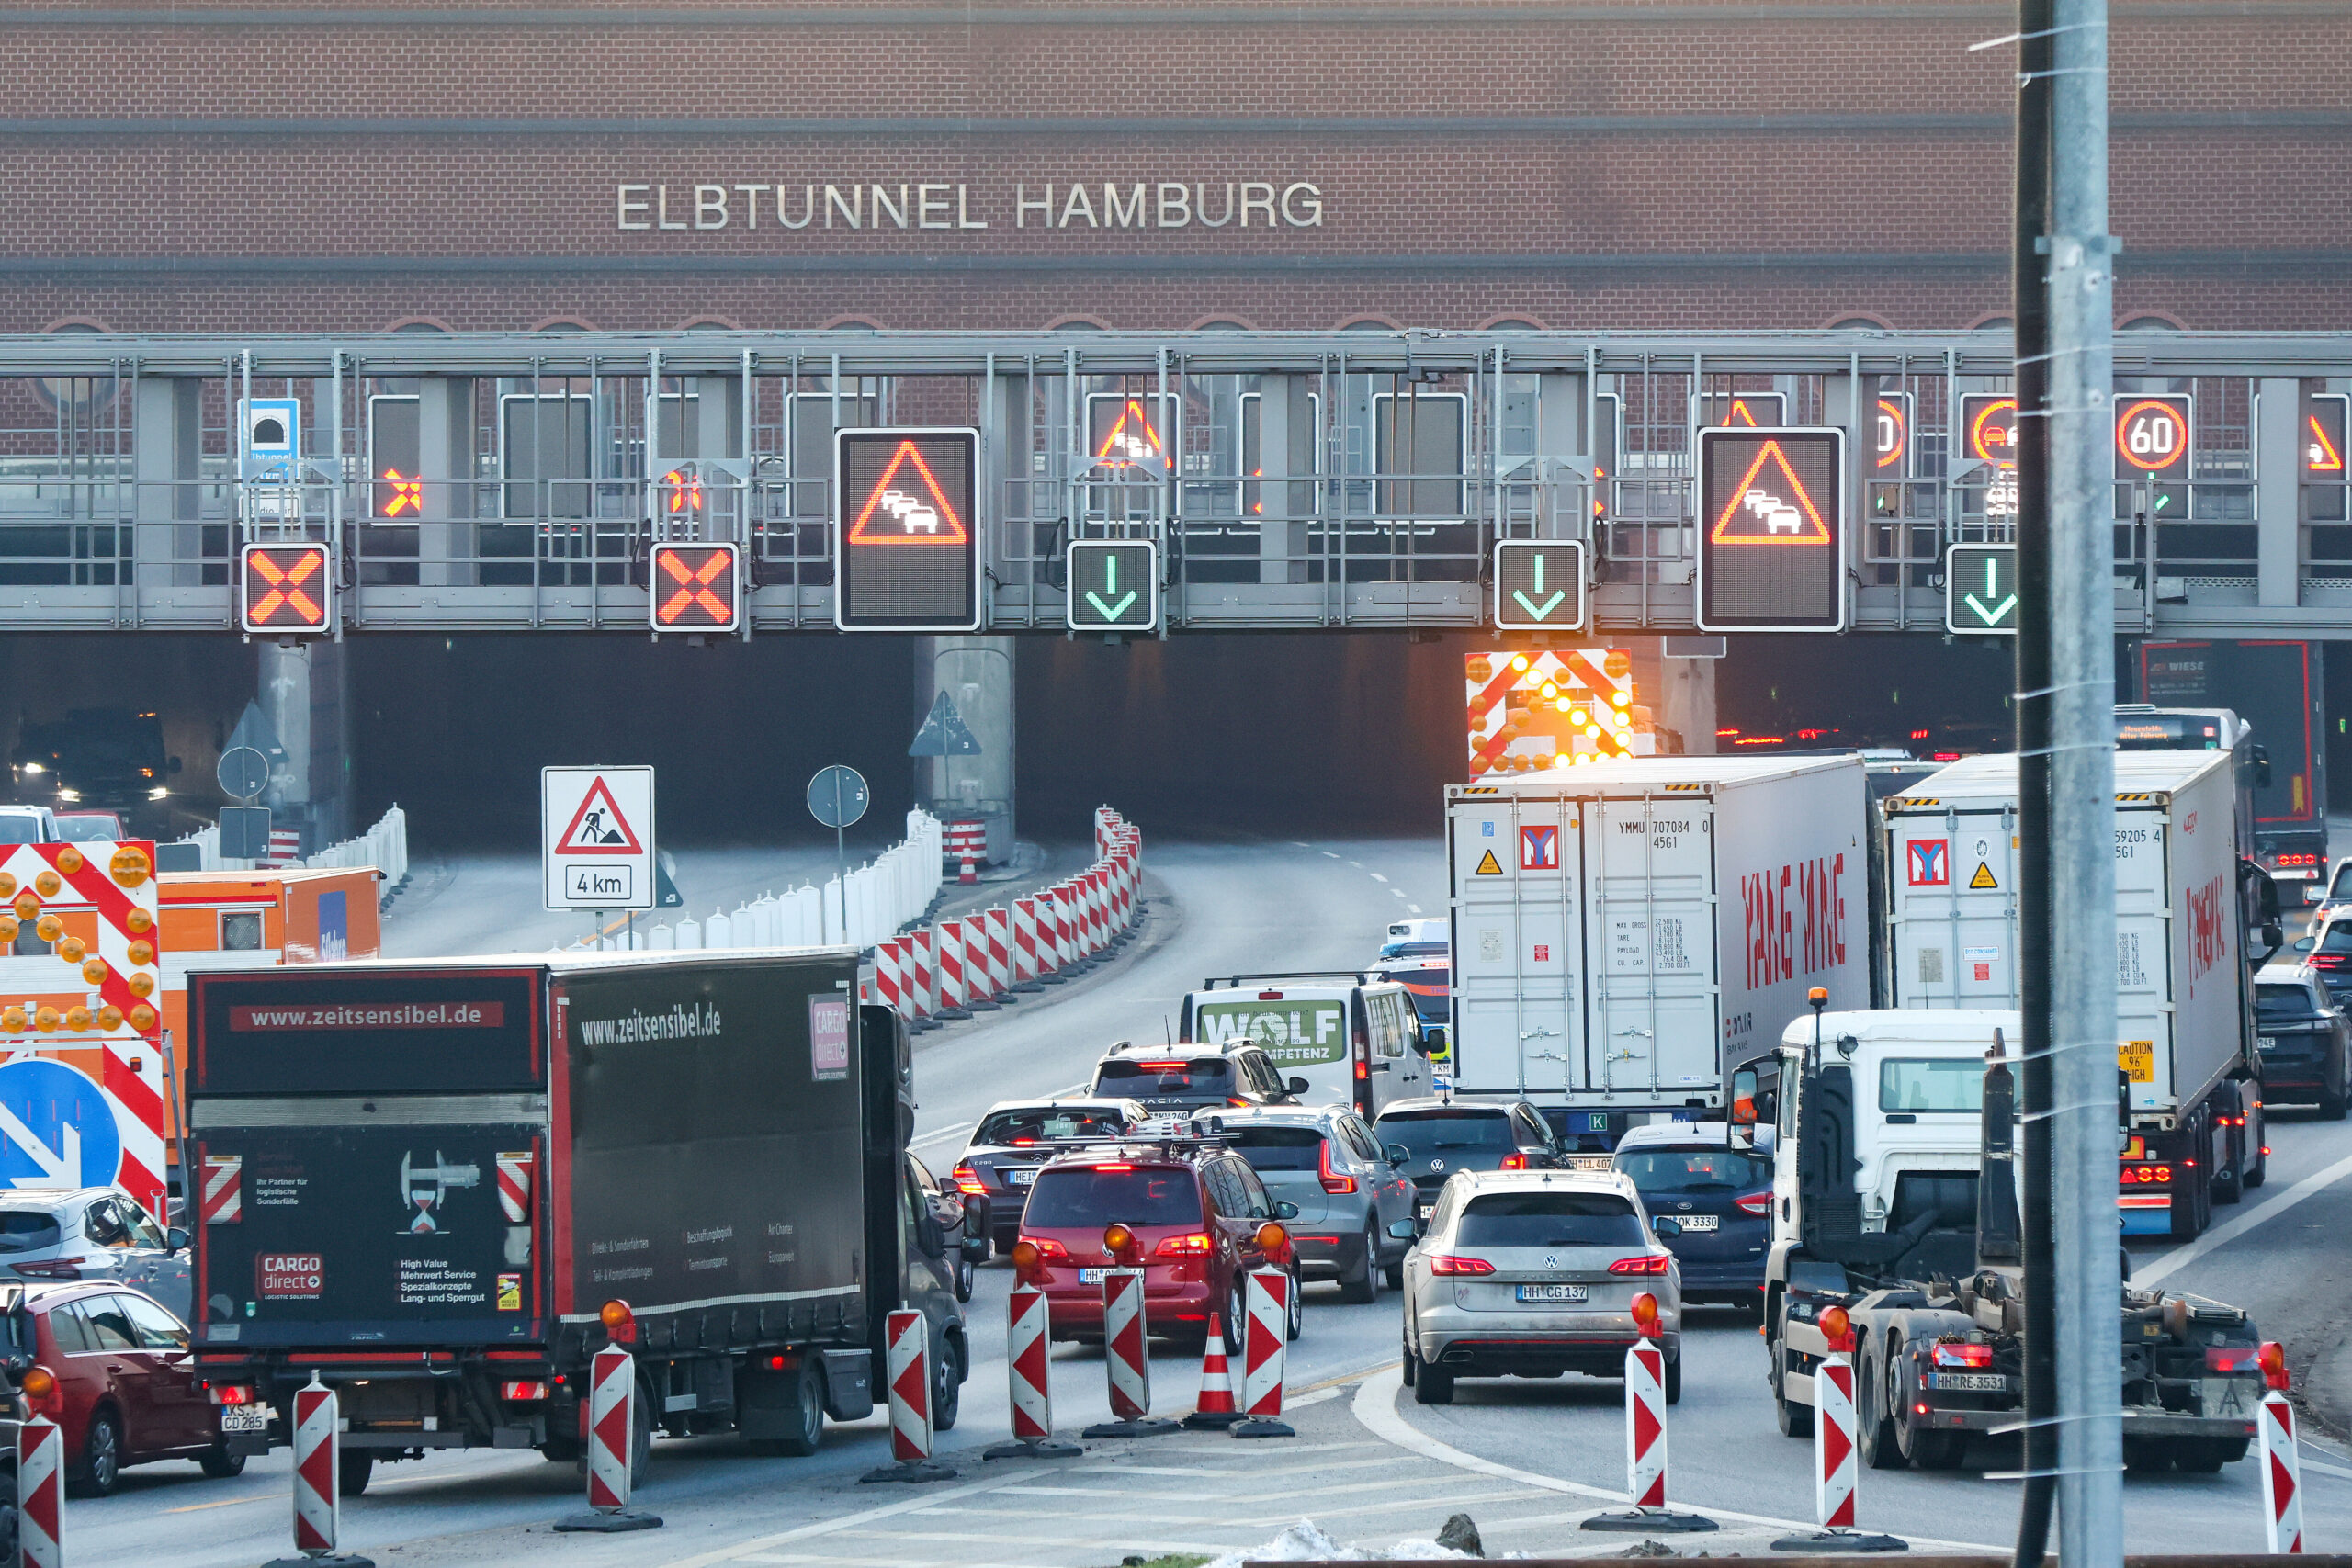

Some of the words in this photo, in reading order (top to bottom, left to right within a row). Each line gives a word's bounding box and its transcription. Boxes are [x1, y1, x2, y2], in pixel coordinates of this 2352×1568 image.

[617, 183, 989, 231] ELBTUNNEL
[1016, 181, 1323, 229] HAMBURG
[2130, 417, 2173, 454] 60
[2169, 661, 2204, 671] WIESE
[1619, 822, 1645, 834] YMMU
[1652, 820, 1690, 834] 707084
[1702, 820, 1709, 833] 0
[1653, 836, 1677, 849] 45G1
[2114, 829, 2146, 843] 59205
[2154, 830, 2160, 843] 4
[2115, 845, 2134, 858] 5G1
[577, 873, 588, 894] 4
[594, 873, 622, 894] km
[1617, 946, 1640, 954] PAYLOAD
[251, 1005, 481, 1027] www.zeitsensibel.de
[816, 1010, 846, 1034] CARGO
[581, 1001, 721, 1046] www.zeitsensibel.de
[1204, 1010, 1340, 1045] WOLF
[2118, 1043, 2153, 1055] CAUTION
[1593, 1116, 1603, 1129] K
[256, 1178, 267, 1186] Ihr
[268, 1178, 296, 1186] Partner
[297, 1178, 309, 1186] für
[1015, 1172, 1032, 1182] HEI
[256, 1188, 297, 1197] logistische
[256, 1197, 300, 1205] Sonderfälle
[1693, 1216, 1717, 1227] 3330
[775, 1222, 794, 1235] Charter
[614, 1238, 650, 1253] Sonderfahrten
[264, 1257, 321, 1272] CARGO
[401, 1259, 422, 1270] High
[424, 1259, 448, 1268] Value
[401, 1270, 442, 1280] Mehrwert
[444, 1270, 477, 1279] Service
[1085, 1269, 1098, 1280] HH
[264, 1274, 307, 1289] direct
[401, 1281, 472, 1292] Spezialkonzepte
[401, 1293, 426, 1304] Lang-
[427, 1293, 445, 1303] und
[447, 1293, 485, 1303] Sperrgut
[1523, 1286, 1540, 1298] HH
[1546, 1286, 1562, 1298] CG
[1564, 1286, 1587, 1298] 137
[1937, 1375, 1952, 1389] HH
[1976, 1376, 2004, 1390] 3531
[224, 1416, 240, 1430] CD
[241, 1416, 263, 1429] 285
